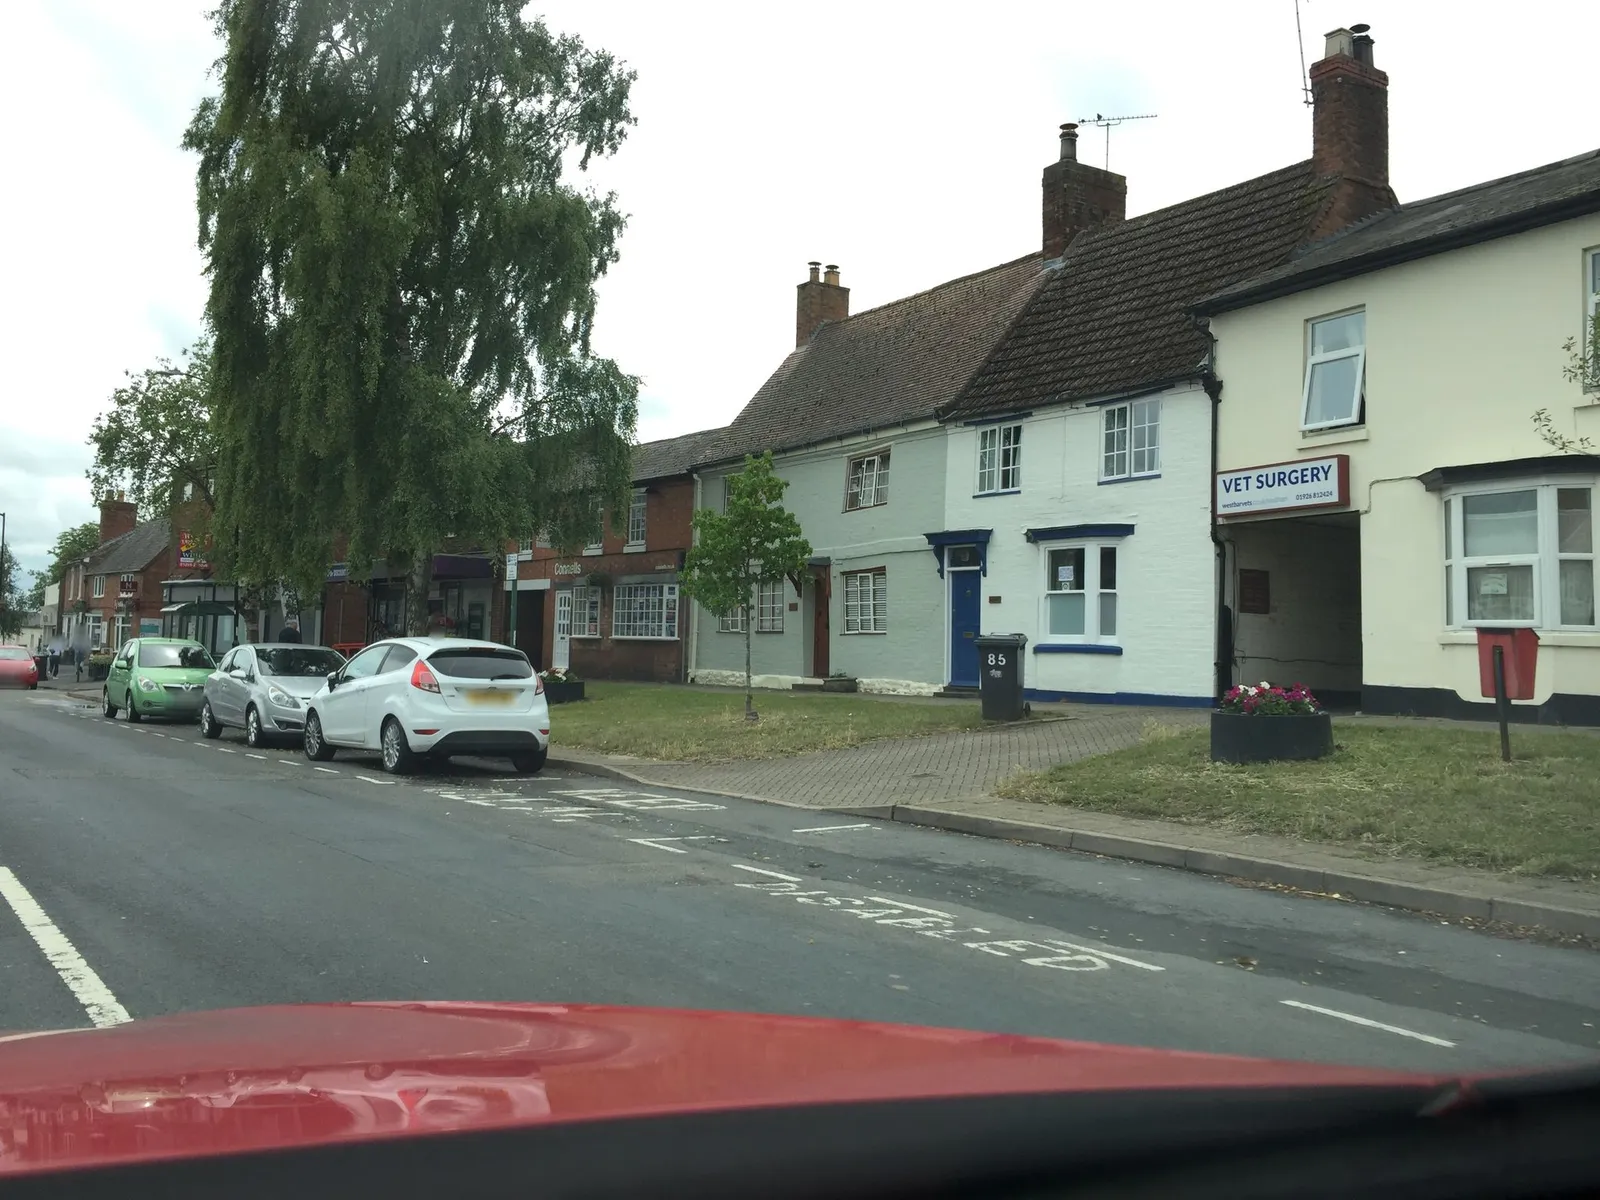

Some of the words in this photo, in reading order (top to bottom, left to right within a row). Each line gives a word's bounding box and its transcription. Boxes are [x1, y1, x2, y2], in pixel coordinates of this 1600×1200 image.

[1222, 475, 1252, 494] VET
[1256, 464, 1332, 490] SURGERY
[1295, 493, 1312, 501] 01926
[554, 561, 581, 575] Connells
[987, 653, 1006, 665] 85
